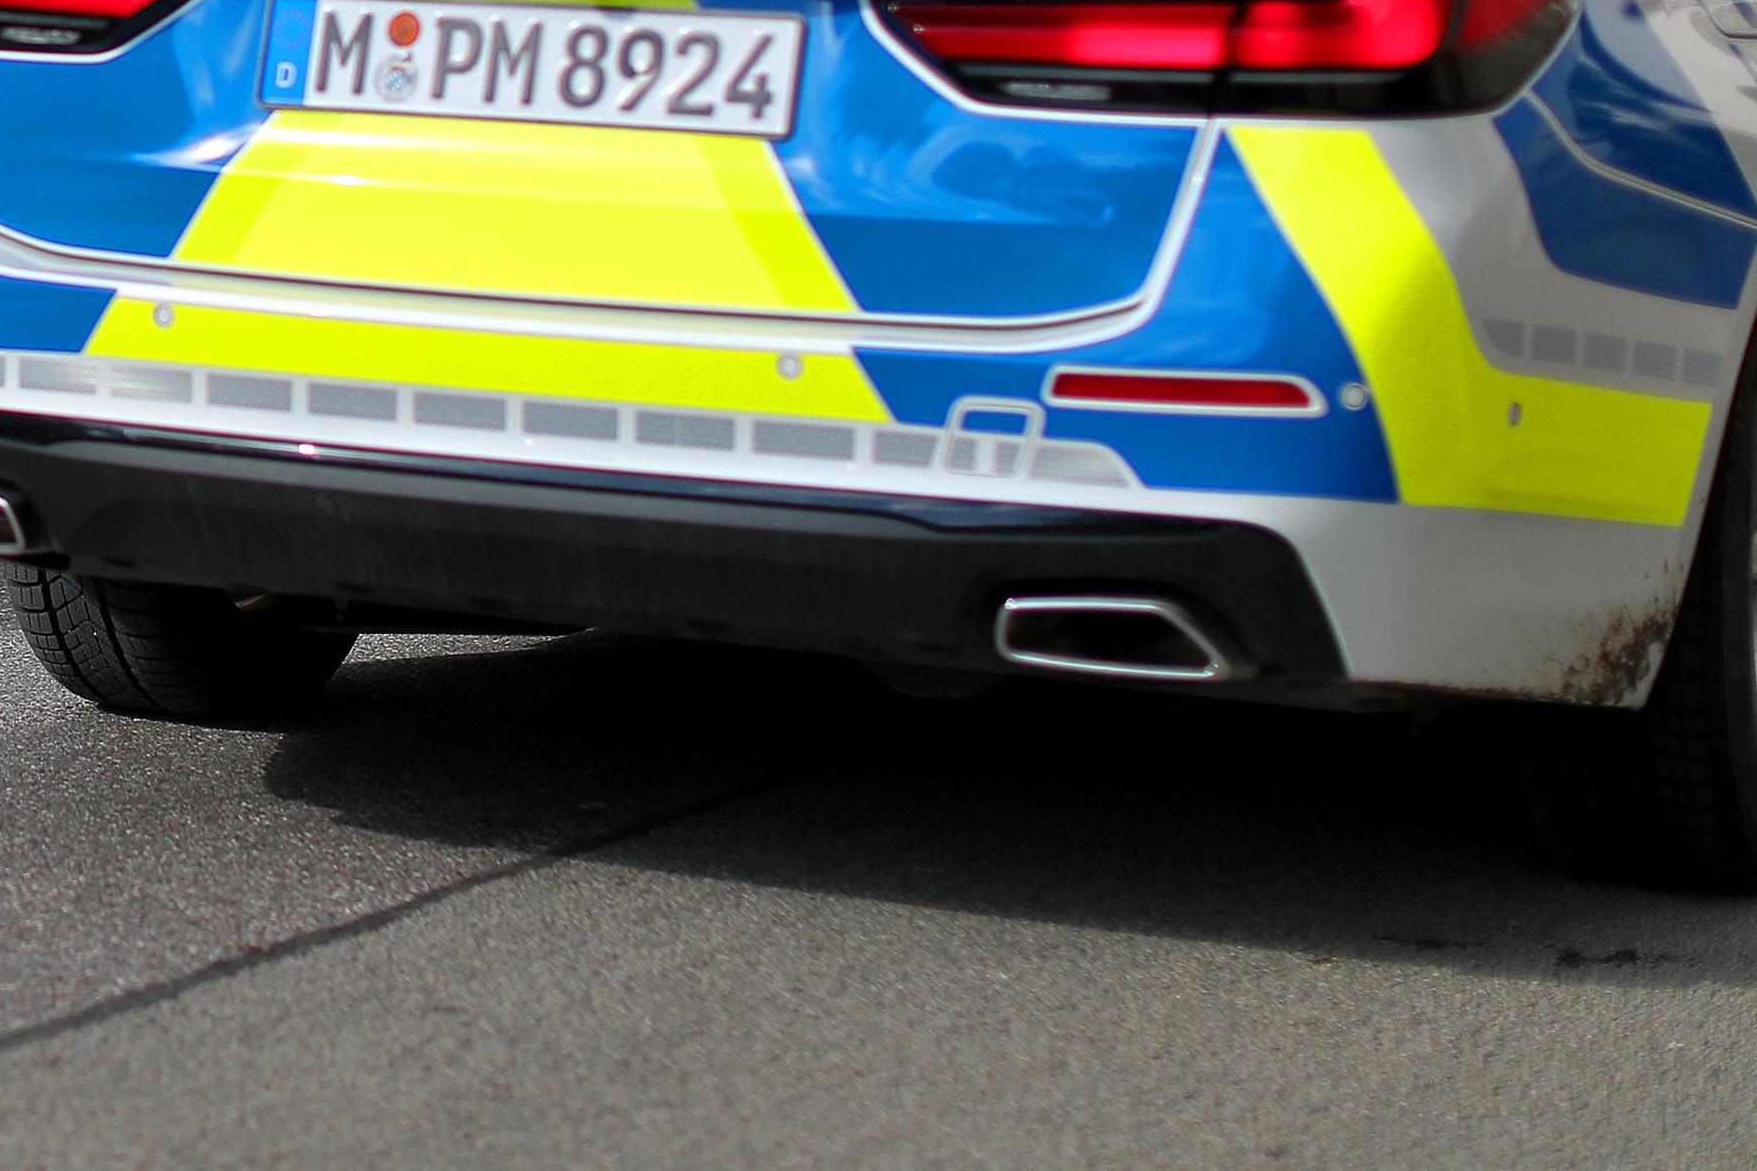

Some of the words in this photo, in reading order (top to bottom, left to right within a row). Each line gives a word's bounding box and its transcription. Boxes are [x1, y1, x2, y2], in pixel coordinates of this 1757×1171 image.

[275, 62, 297, 88] D
[313, 8, 373, 95] M
[430, 10, 542, 105] PM
[558, 20, 774, 119] 8924
